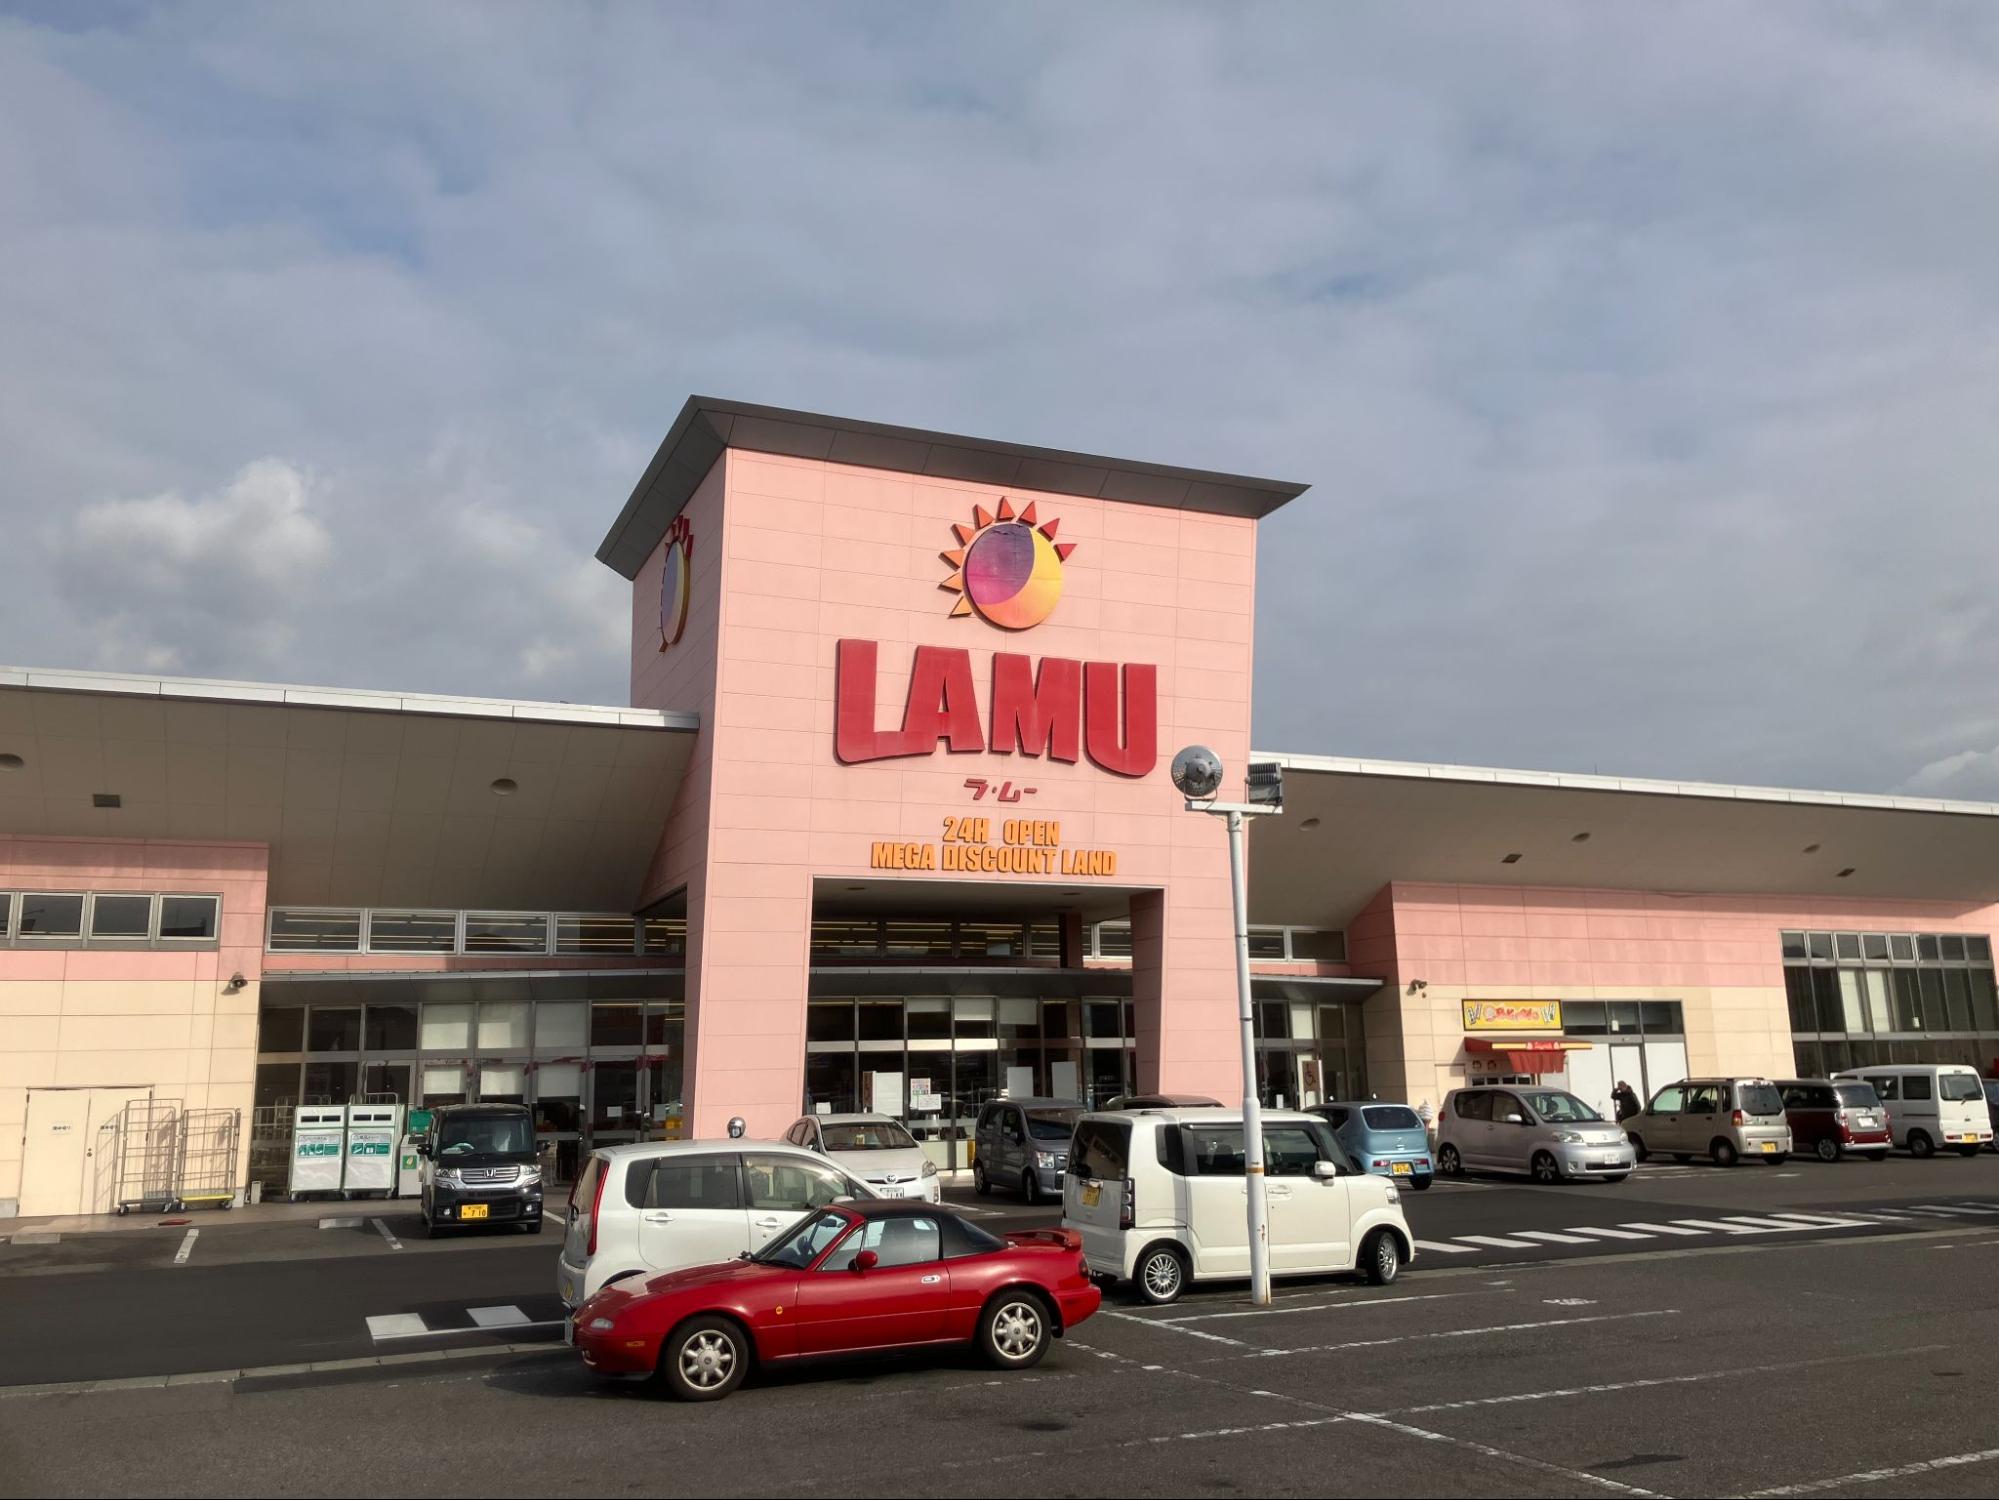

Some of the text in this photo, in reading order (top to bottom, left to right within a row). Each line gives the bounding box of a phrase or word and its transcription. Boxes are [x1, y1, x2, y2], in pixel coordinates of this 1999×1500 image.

[835, 638, 1157, 778] LAMU
[963, 778, 1038, 802] ラ・ムー
[942, 816, 1060, 846] 24H OPEN
[871, 842, 1117, 875] MEGA DISCOUNT LAND
